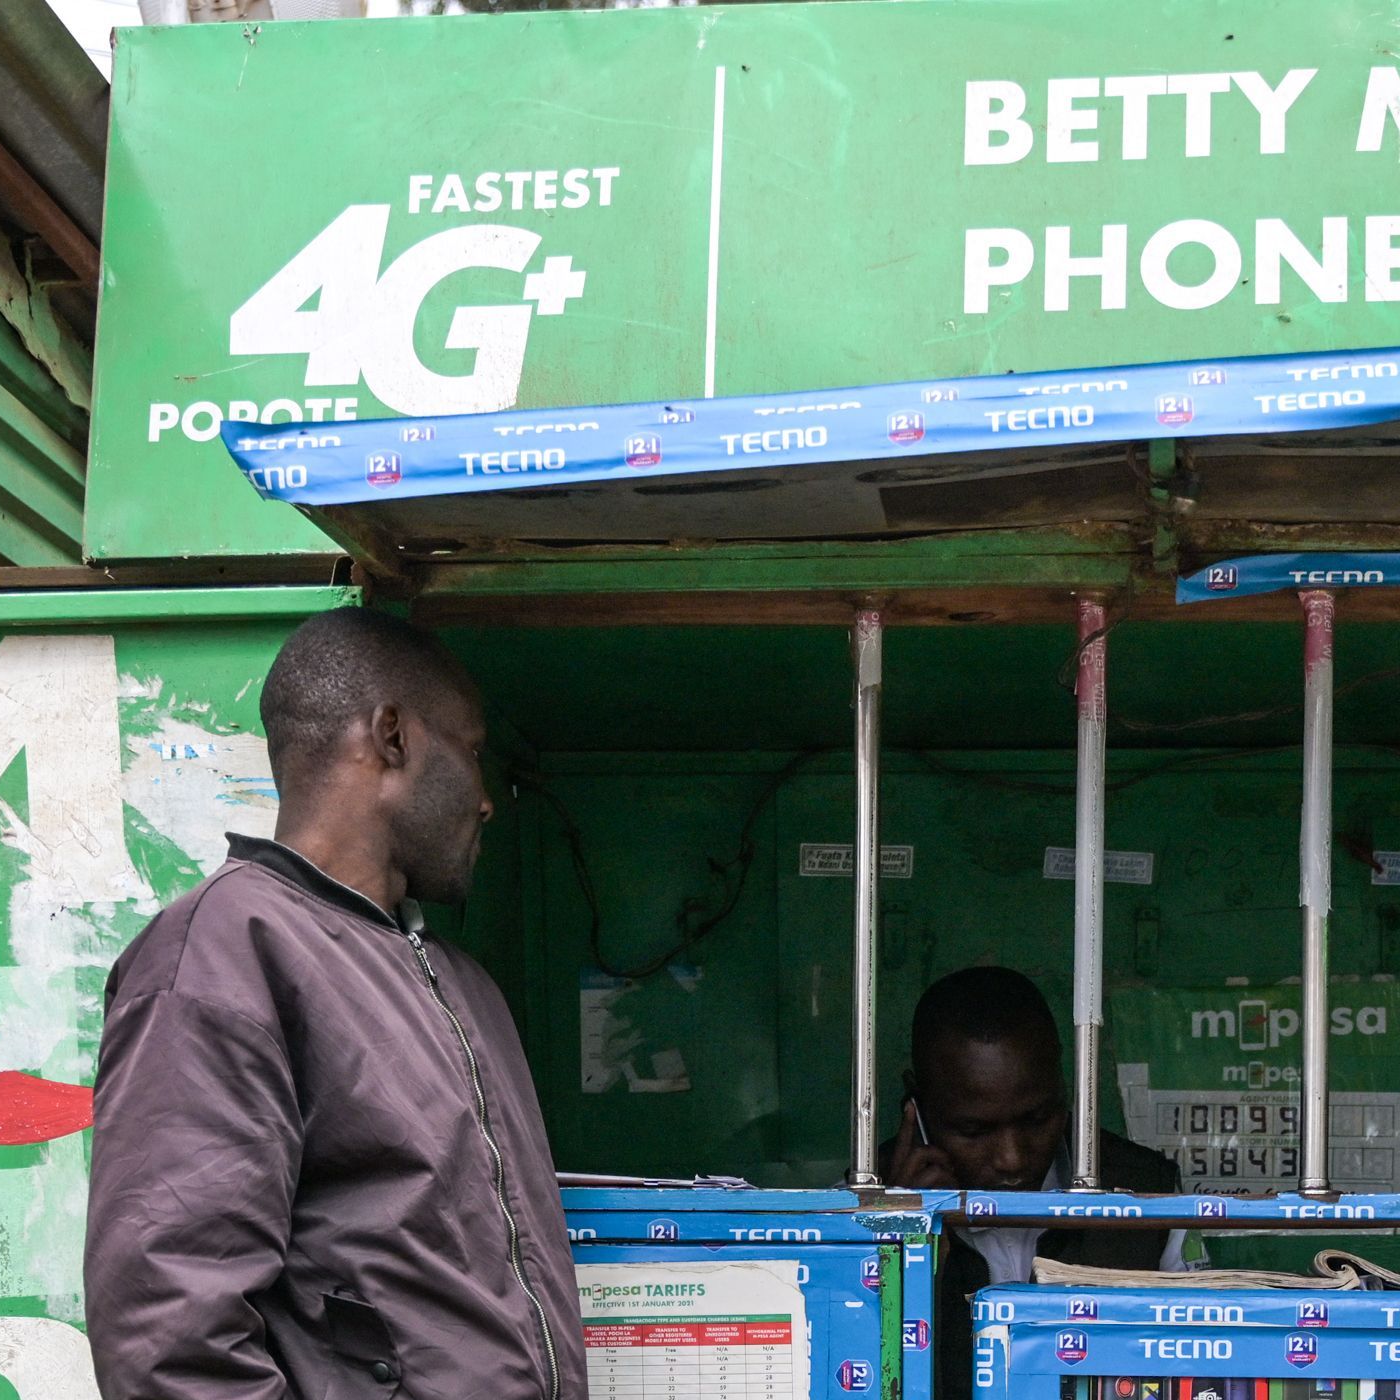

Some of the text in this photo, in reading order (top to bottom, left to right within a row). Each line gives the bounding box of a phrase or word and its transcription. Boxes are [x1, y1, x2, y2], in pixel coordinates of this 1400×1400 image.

[964, 68, 1319, 166] BETTY
[408, 166, 620, 215] FASTEST
[1253, 388, 1366, 414] TECNO
[985, 403, 1095, 433] TECNO
[721, 426, 827, 455] TECNO
[459, 447, 566, 475] TECNO
[644, 1283, 706, 1297] TARIFFS
[592, 1301, 626, 1309] EFFECTIVE
[641, 1300, 675, 1308] JANUARY
